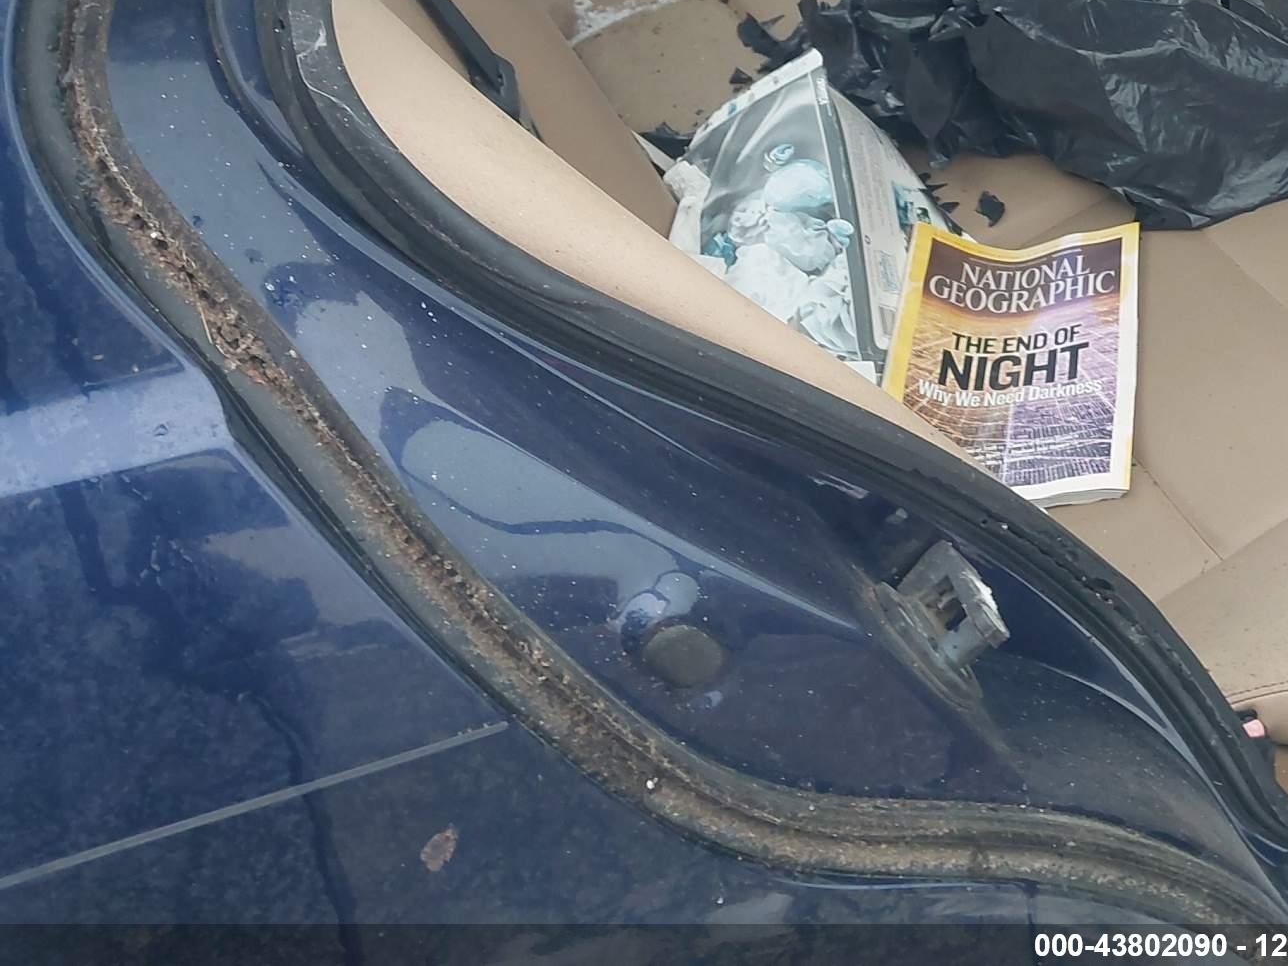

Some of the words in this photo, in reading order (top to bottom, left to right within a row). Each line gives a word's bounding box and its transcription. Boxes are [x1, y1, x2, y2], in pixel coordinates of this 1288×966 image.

[960, 255, 1090, 291] NATIONAL
[929, 270, 1116, 314] GEOGRAPHIC
[952, 332, 998, 355] THE
[1002, 333, 1048, 353] END
[1053, 324, 1083, 345] OF
[938, 342, 1089, 392] NIGHT
[918, 378, 951, 407] Why
[955, 390, 981, 408] We
[984, 385, 1025, 408] Need
[1027, 378, 1103, 402] Darkness
